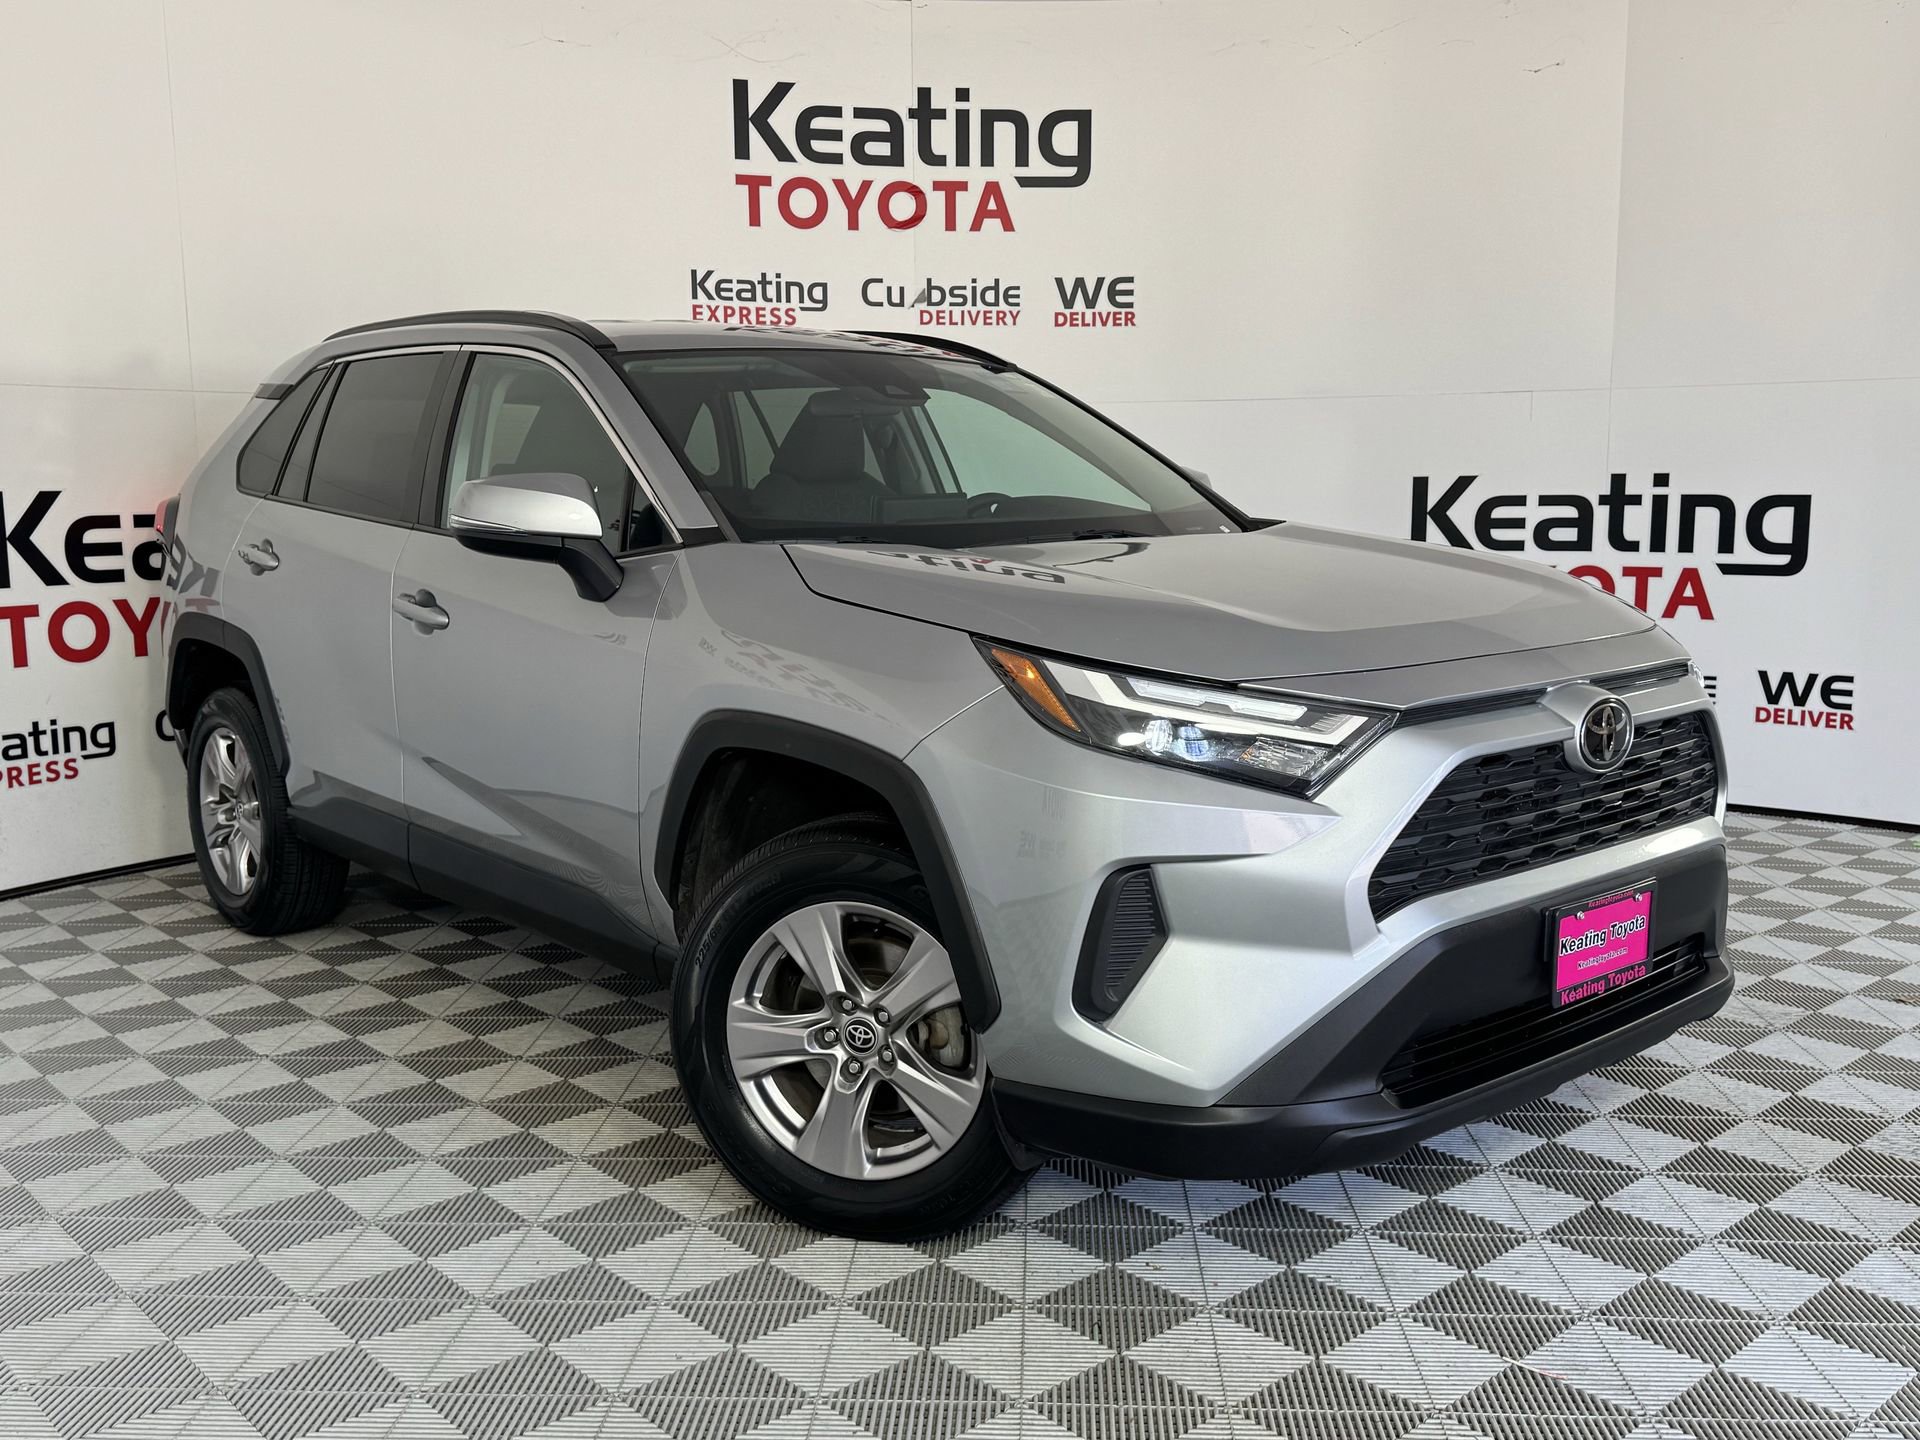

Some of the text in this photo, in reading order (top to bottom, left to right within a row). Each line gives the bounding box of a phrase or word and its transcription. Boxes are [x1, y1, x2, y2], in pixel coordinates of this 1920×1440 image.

[732, 78, 1092, 188] Keating
[735, 174, 1016, 233] TOYOTA
[691, 269, 828, 312] Keating
[861, 278, 1021, 307] Cubside
[1055, 276, 1135, 309] WE
[692, 304, 797, 326] EXPRESS
[919, 309, 1021, 326] DELIVERY
[1054, 312, 1136, 327] DELIVER
[1411, 473, 1812, 577] Keating
[1758, 670, 1855, 711] WE
[1755, 707, 1855, 731] DELIVER
[0, 758, 79, 789] RESS
[1560, 915, 1646, 957] Keating Toyota
[1561, 964, 1646, 1006] Keating Toyota
